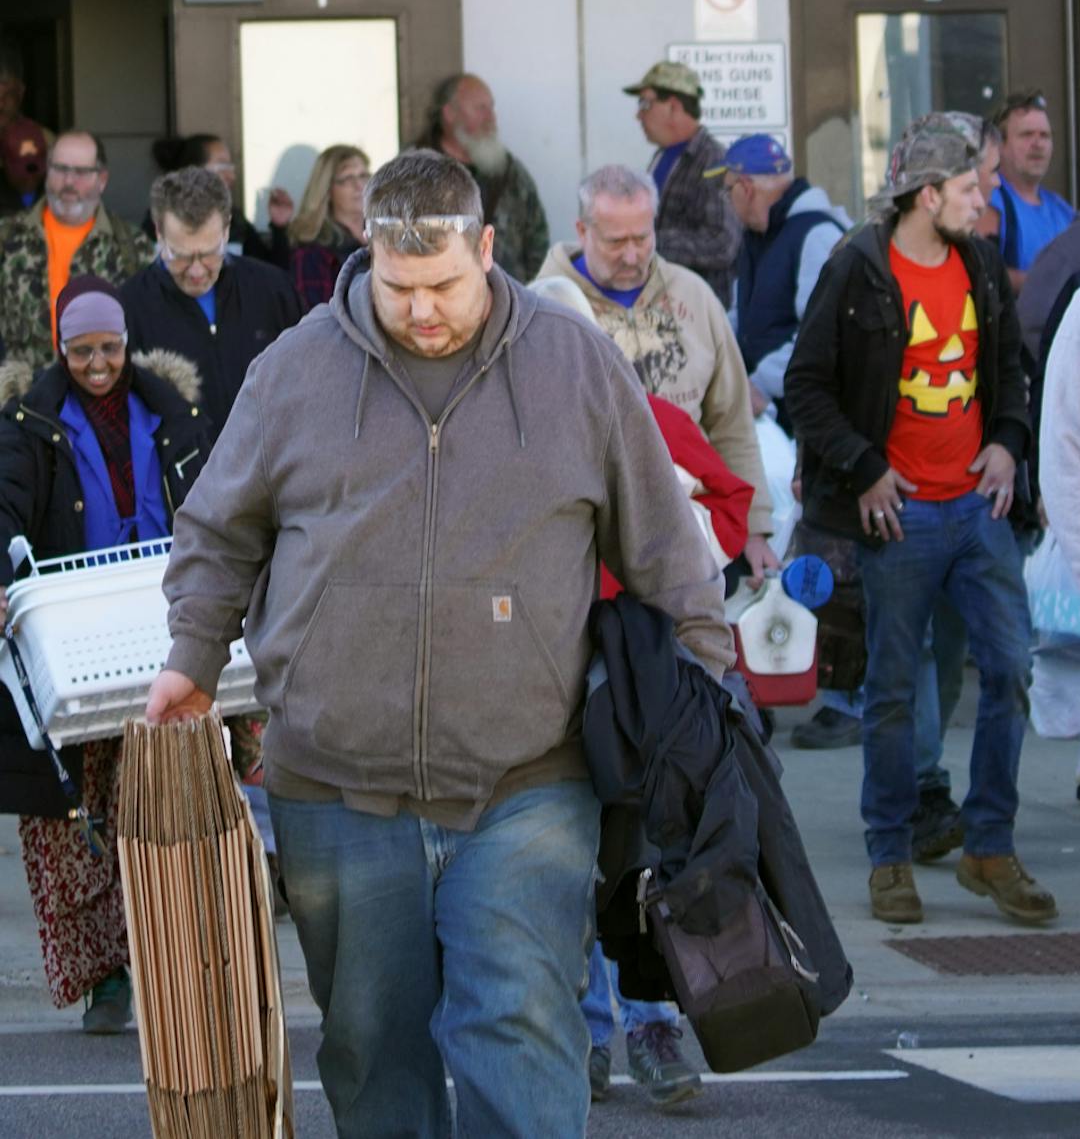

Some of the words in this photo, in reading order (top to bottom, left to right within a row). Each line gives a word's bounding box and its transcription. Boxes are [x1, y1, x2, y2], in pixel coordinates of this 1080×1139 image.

[730, 68, 773, 82] GUNS
[713, 87, 762, 100] THESE
[702, 105, 767, 119] REMISES
